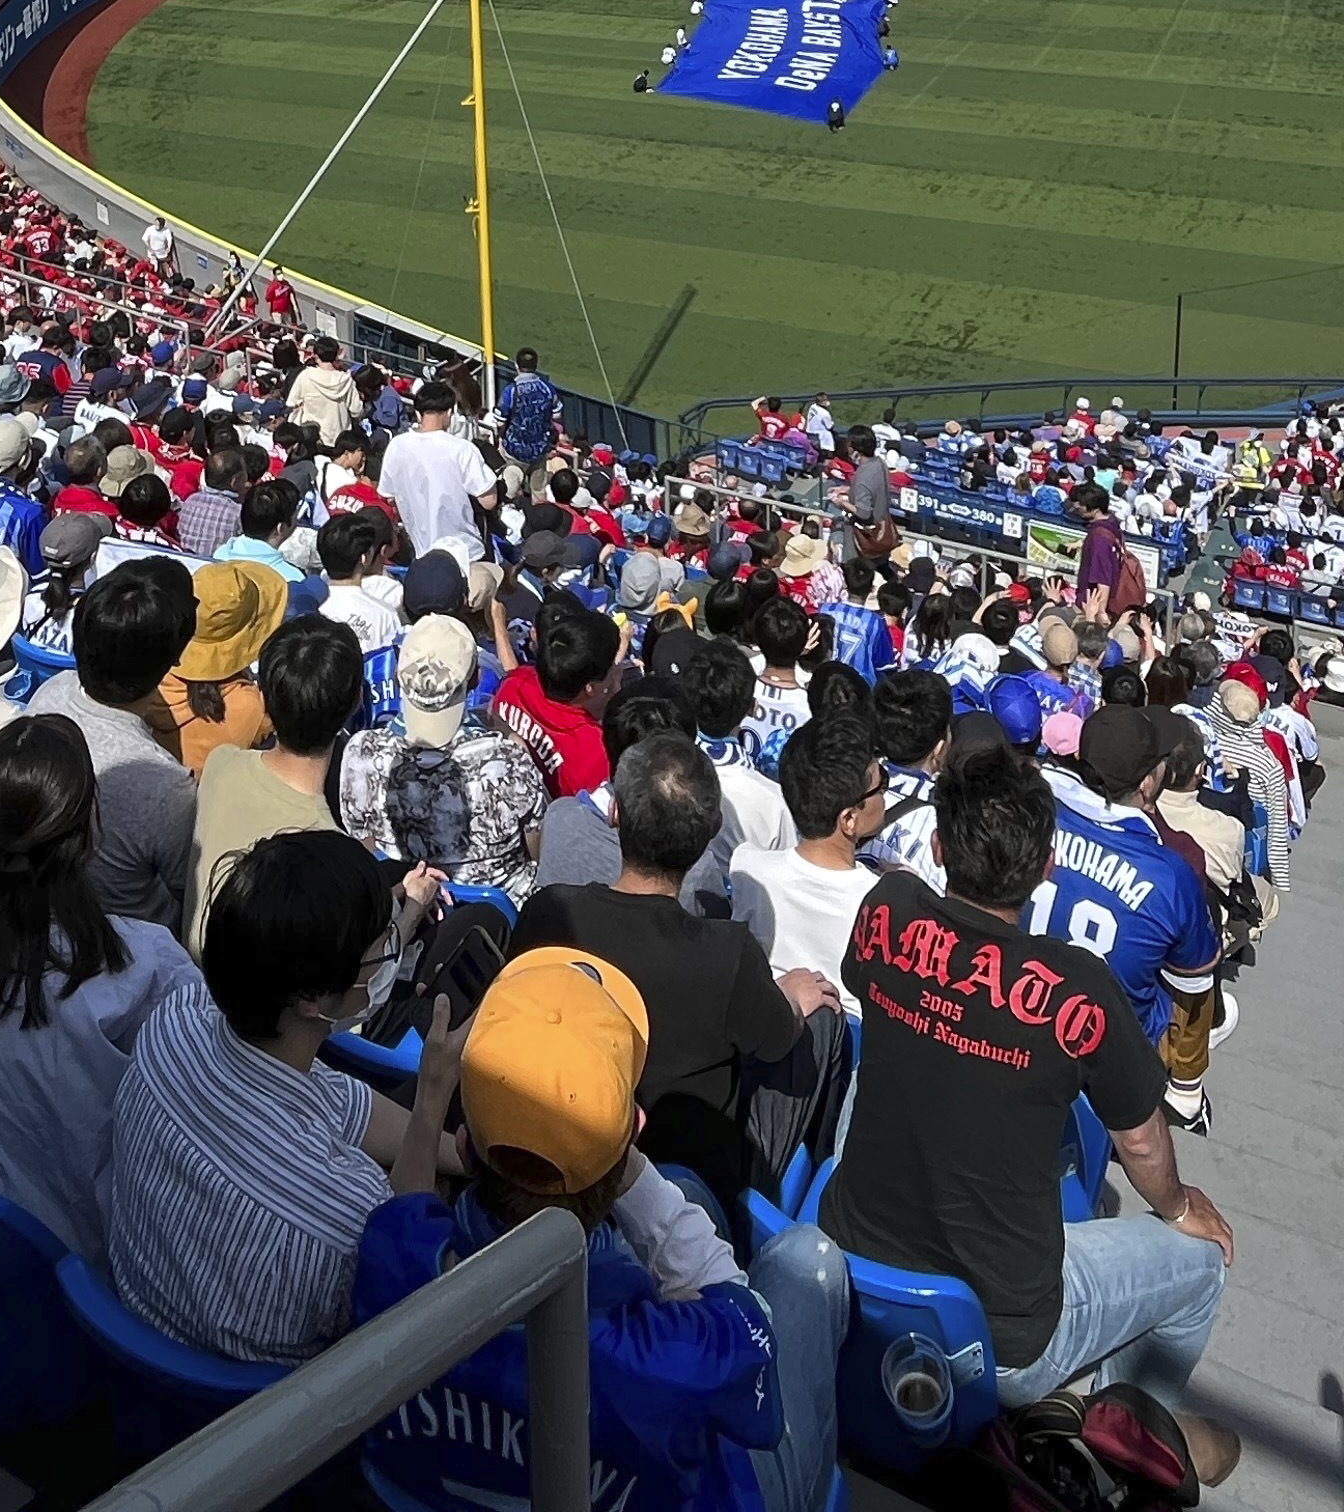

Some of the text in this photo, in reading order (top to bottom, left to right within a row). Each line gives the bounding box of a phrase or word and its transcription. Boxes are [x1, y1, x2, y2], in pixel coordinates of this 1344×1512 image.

[717, 8, 789, 79] YOKOHAMA
[773, 50, 839, 92] DeNA
[498, 700, 565, 777] KURODA
[919, 990, 965, 1022] 2005
[933, 1021, 1032, 1070] Nagabuchi
